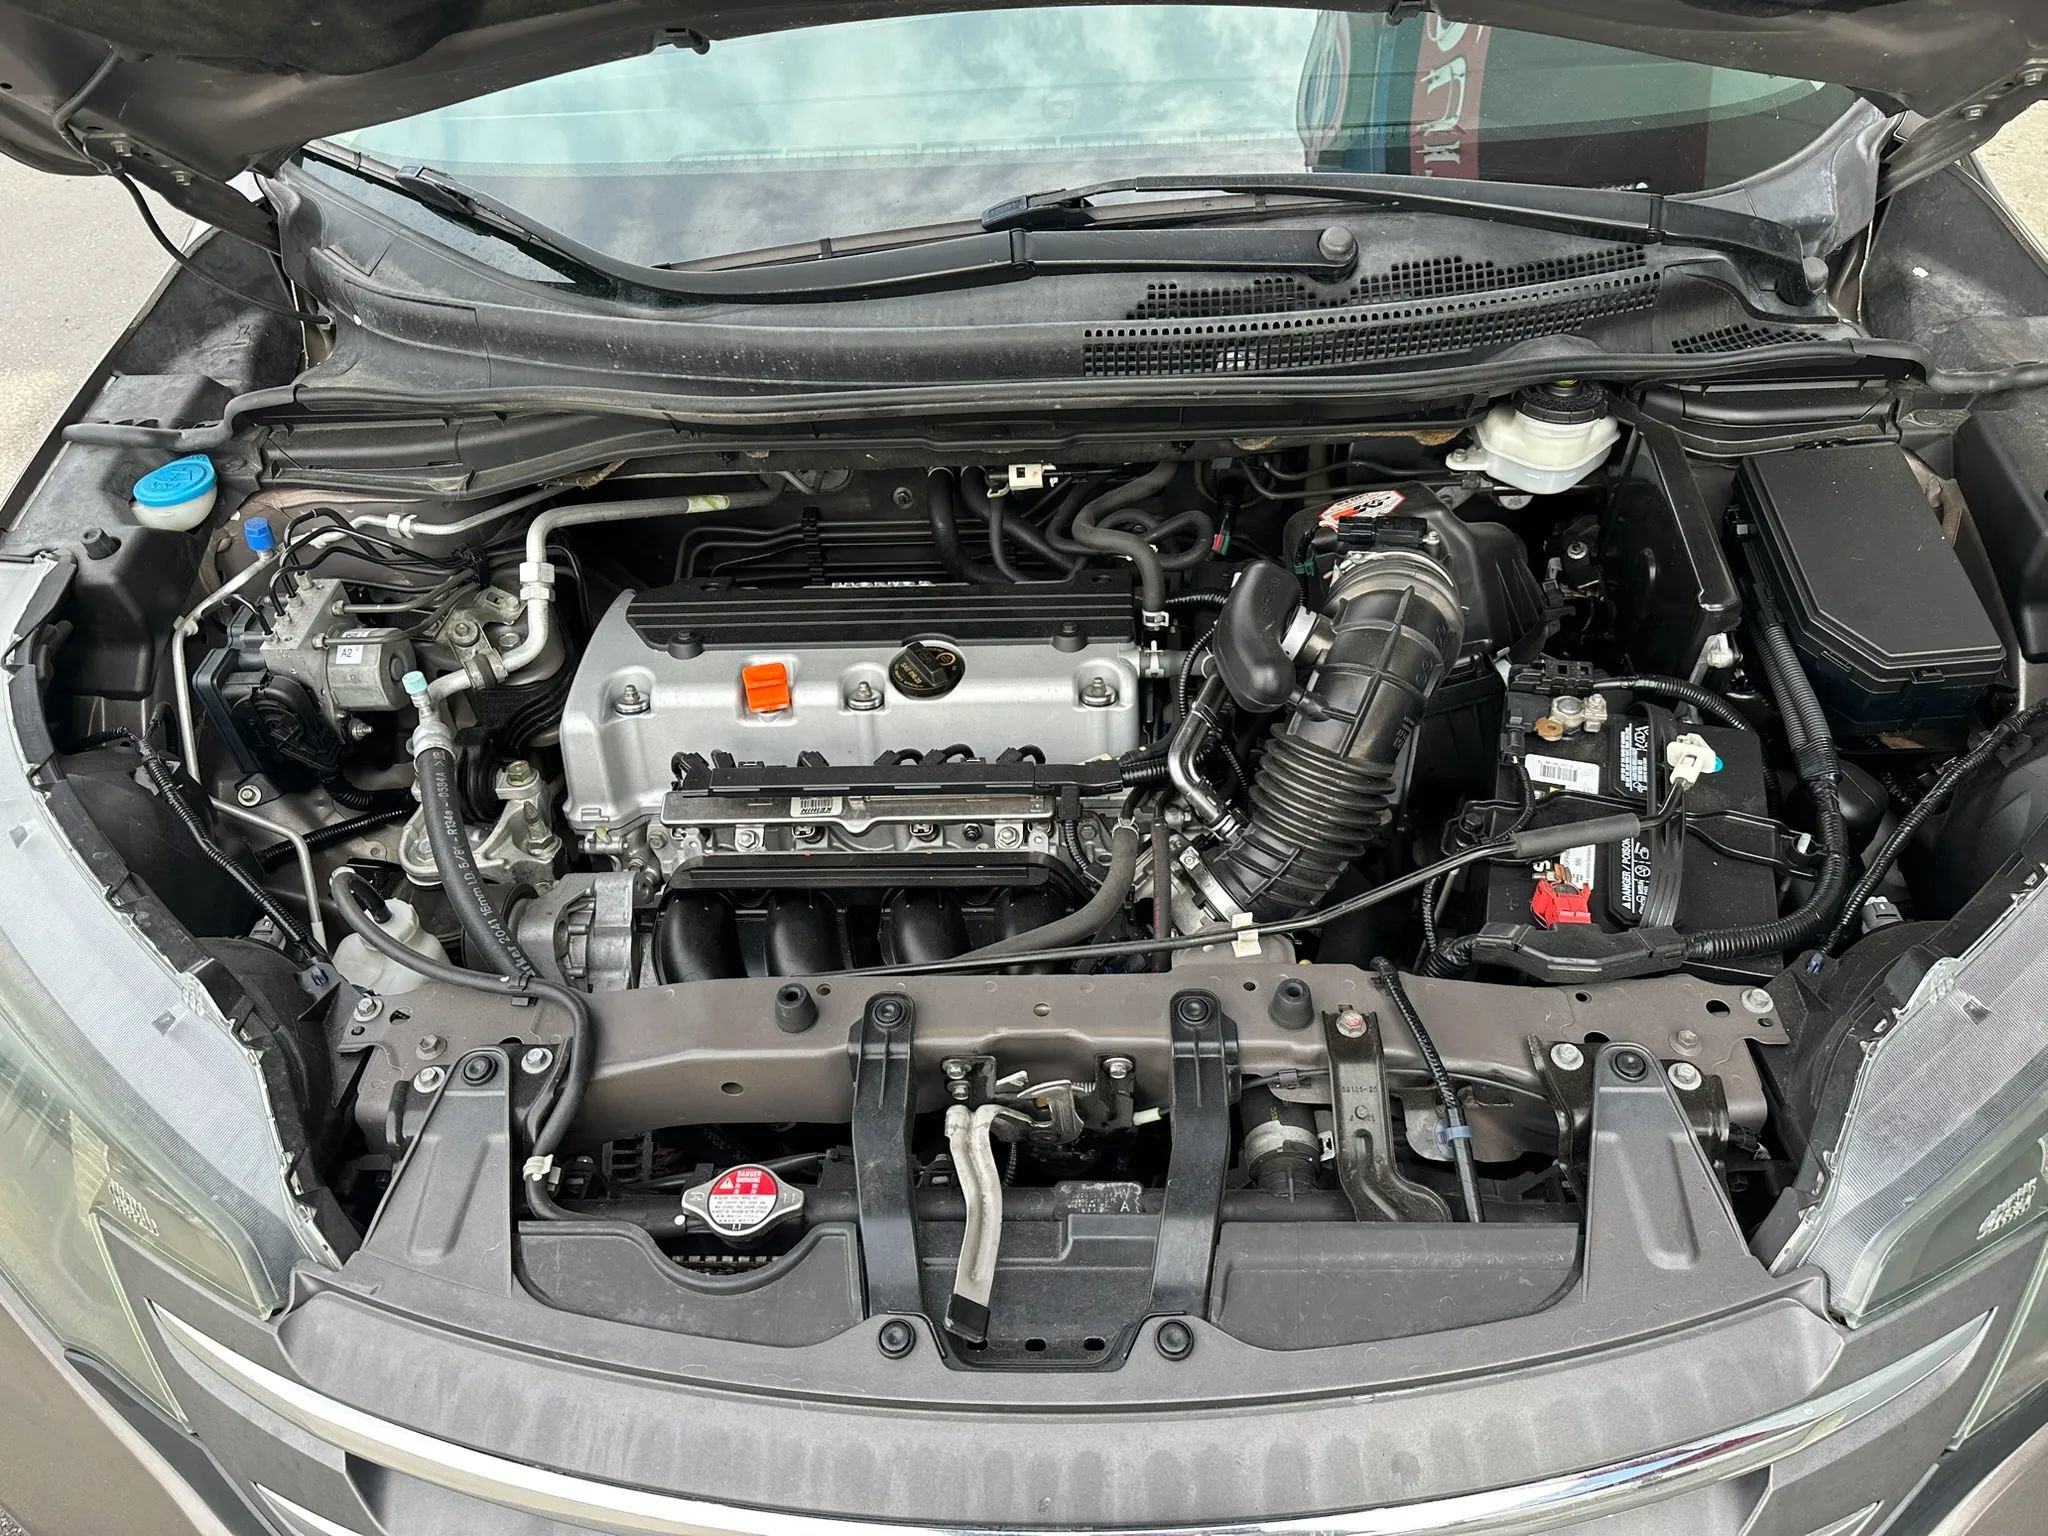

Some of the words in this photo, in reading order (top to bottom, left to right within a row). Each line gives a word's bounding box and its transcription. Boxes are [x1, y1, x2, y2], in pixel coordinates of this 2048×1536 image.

[341, 648, 353, 658] A2
[443, 810, 459, 836] R134a
[800, 807, 832, 815] KEIHIN
[1621, 871, 1631, 902] DANGER
[473, 886, 493, 917] 16mm
[487, 918, 511, 945] 2041
